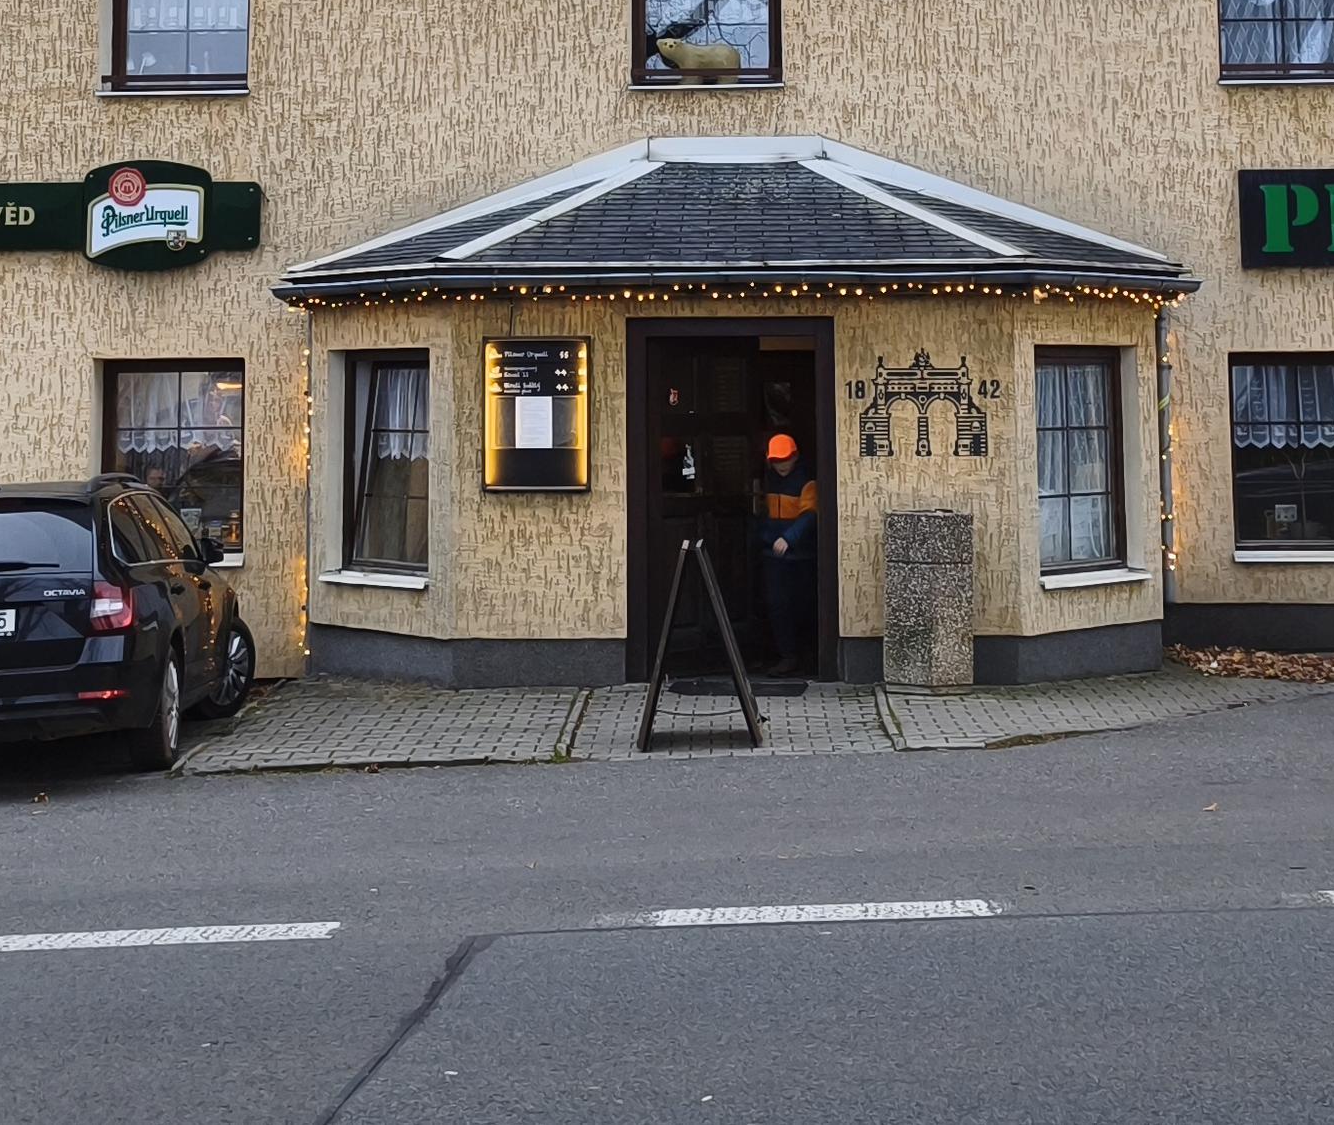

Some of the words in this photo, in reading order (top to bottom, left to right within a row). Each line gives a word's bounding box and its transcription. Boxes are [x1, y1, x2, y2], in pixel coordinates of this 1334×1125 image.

[101, 205, 145, 237] Pilsner
[145, 204, 188, 227] Urquell
[845, 380, 866, 400] 18
[978, 379, 1001, 399] 42
[43, 588, 86, 597] OCTAVIA
